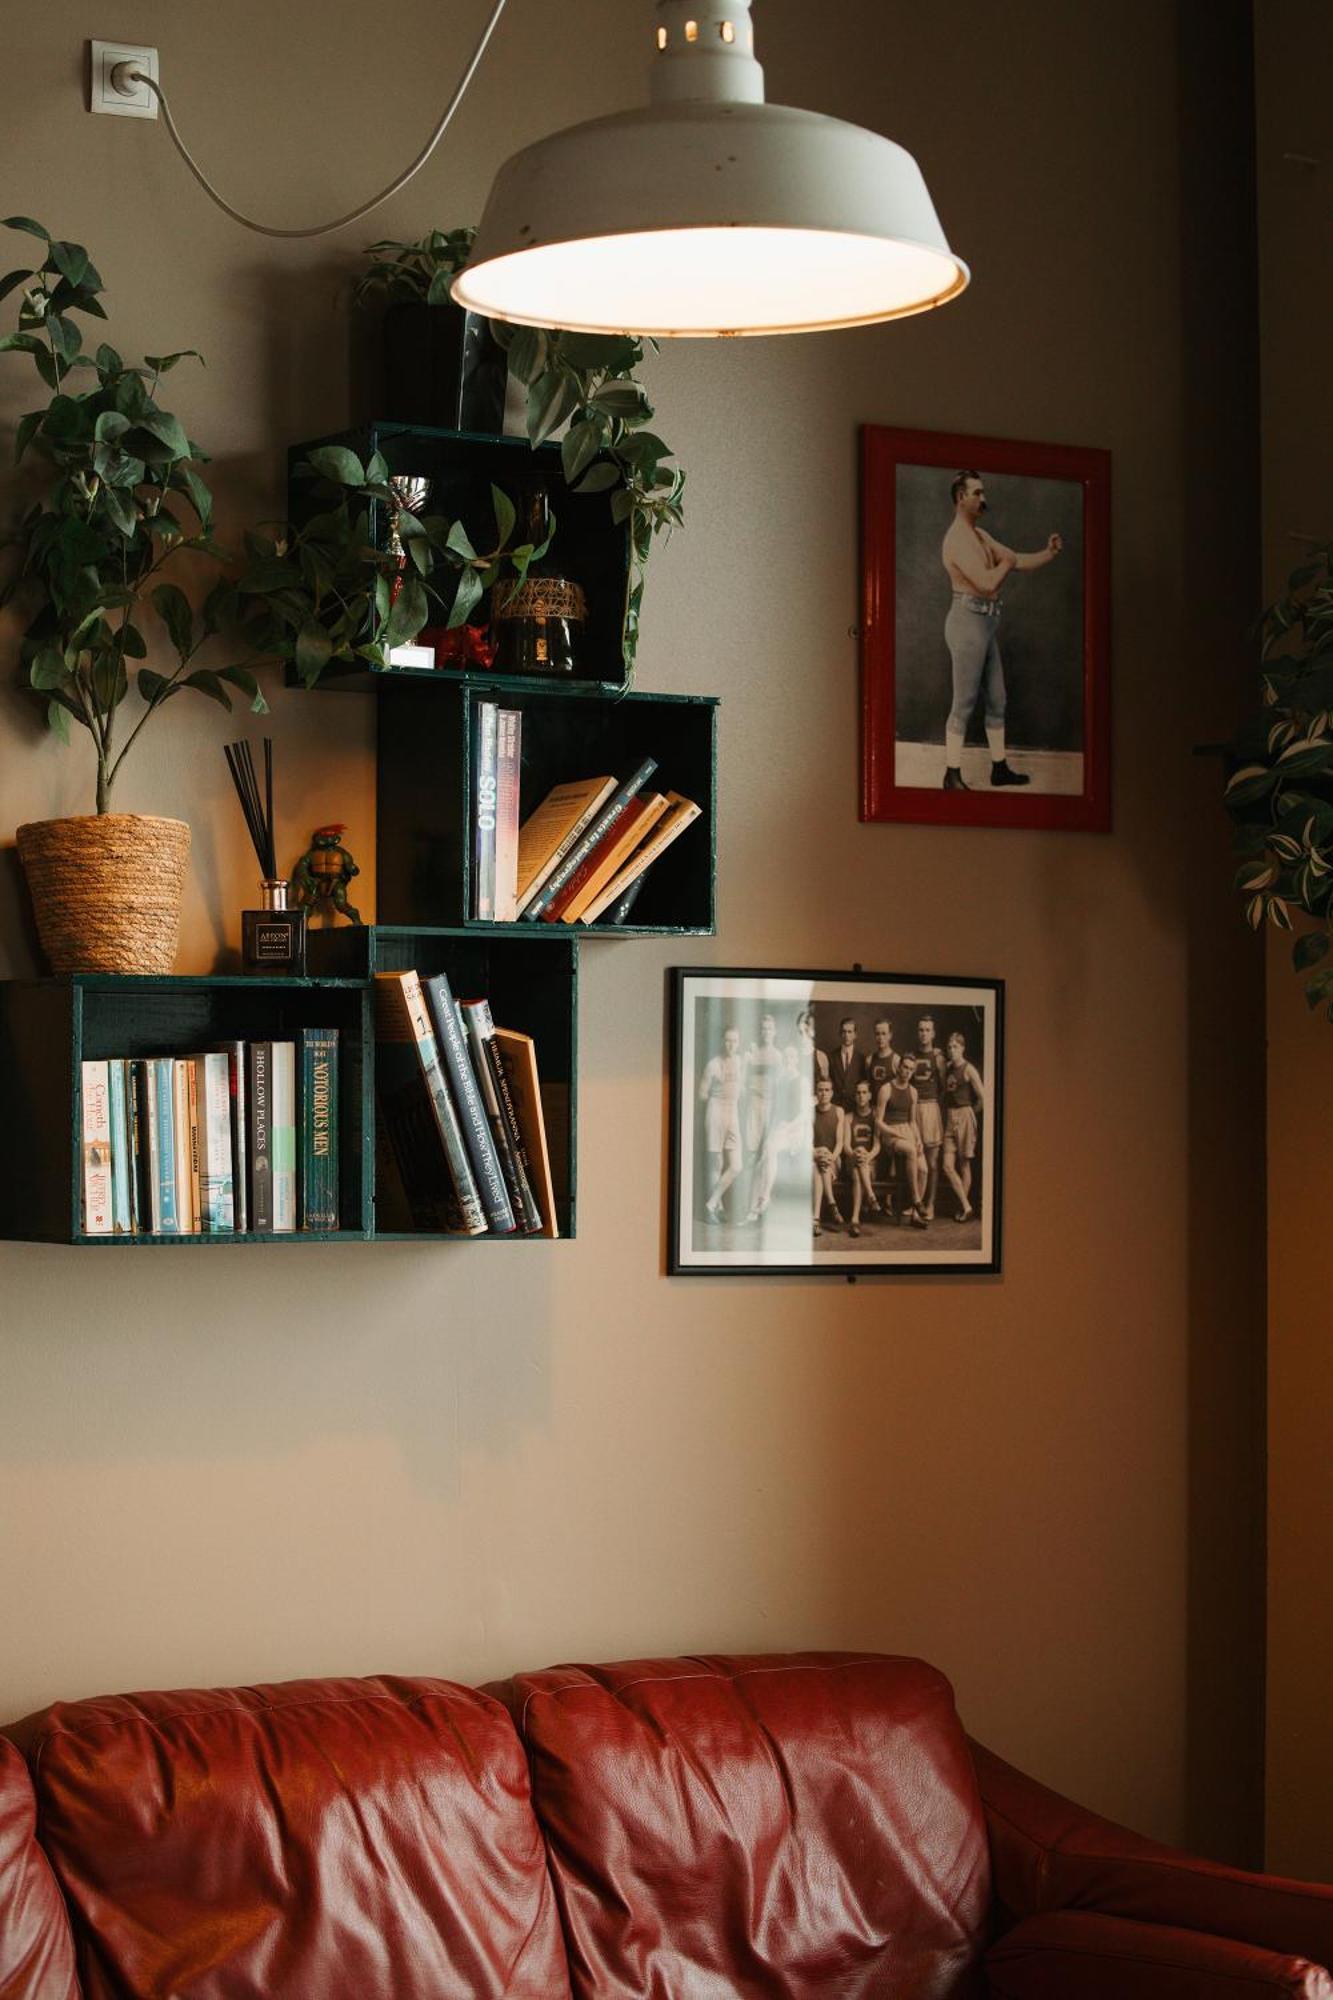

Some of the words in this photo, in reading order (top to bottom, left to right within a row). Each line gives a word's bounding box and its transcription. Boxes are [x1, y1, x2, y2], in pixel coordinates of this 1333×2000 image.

[478, 775, 496, 831] SOLO
[547, 839, 592, 893] photography
[439, 989, 452, 1018] Great
[446, 1018, 461, 1051] People
[454, 1051, 465, 1063] of
[457, 1061, 469, 1080] the
[256, 1056, 265, 1108] HOLLOW
[312, 1062, 329, 1128] NOTORIOUS
[463, 1080, 475, 1105] Bible
[95, 1083, 107, 1129] Cometh
[470, 1105, 481, 1126] and
[256, 1110, 265, 1150] PLACES
[313, 1129, 329, 1156] MEN
[475, 1128, 488, 1151] How
[481, 1151, 495, 1176] They
[488, 1176, 501, 1201] Lived
